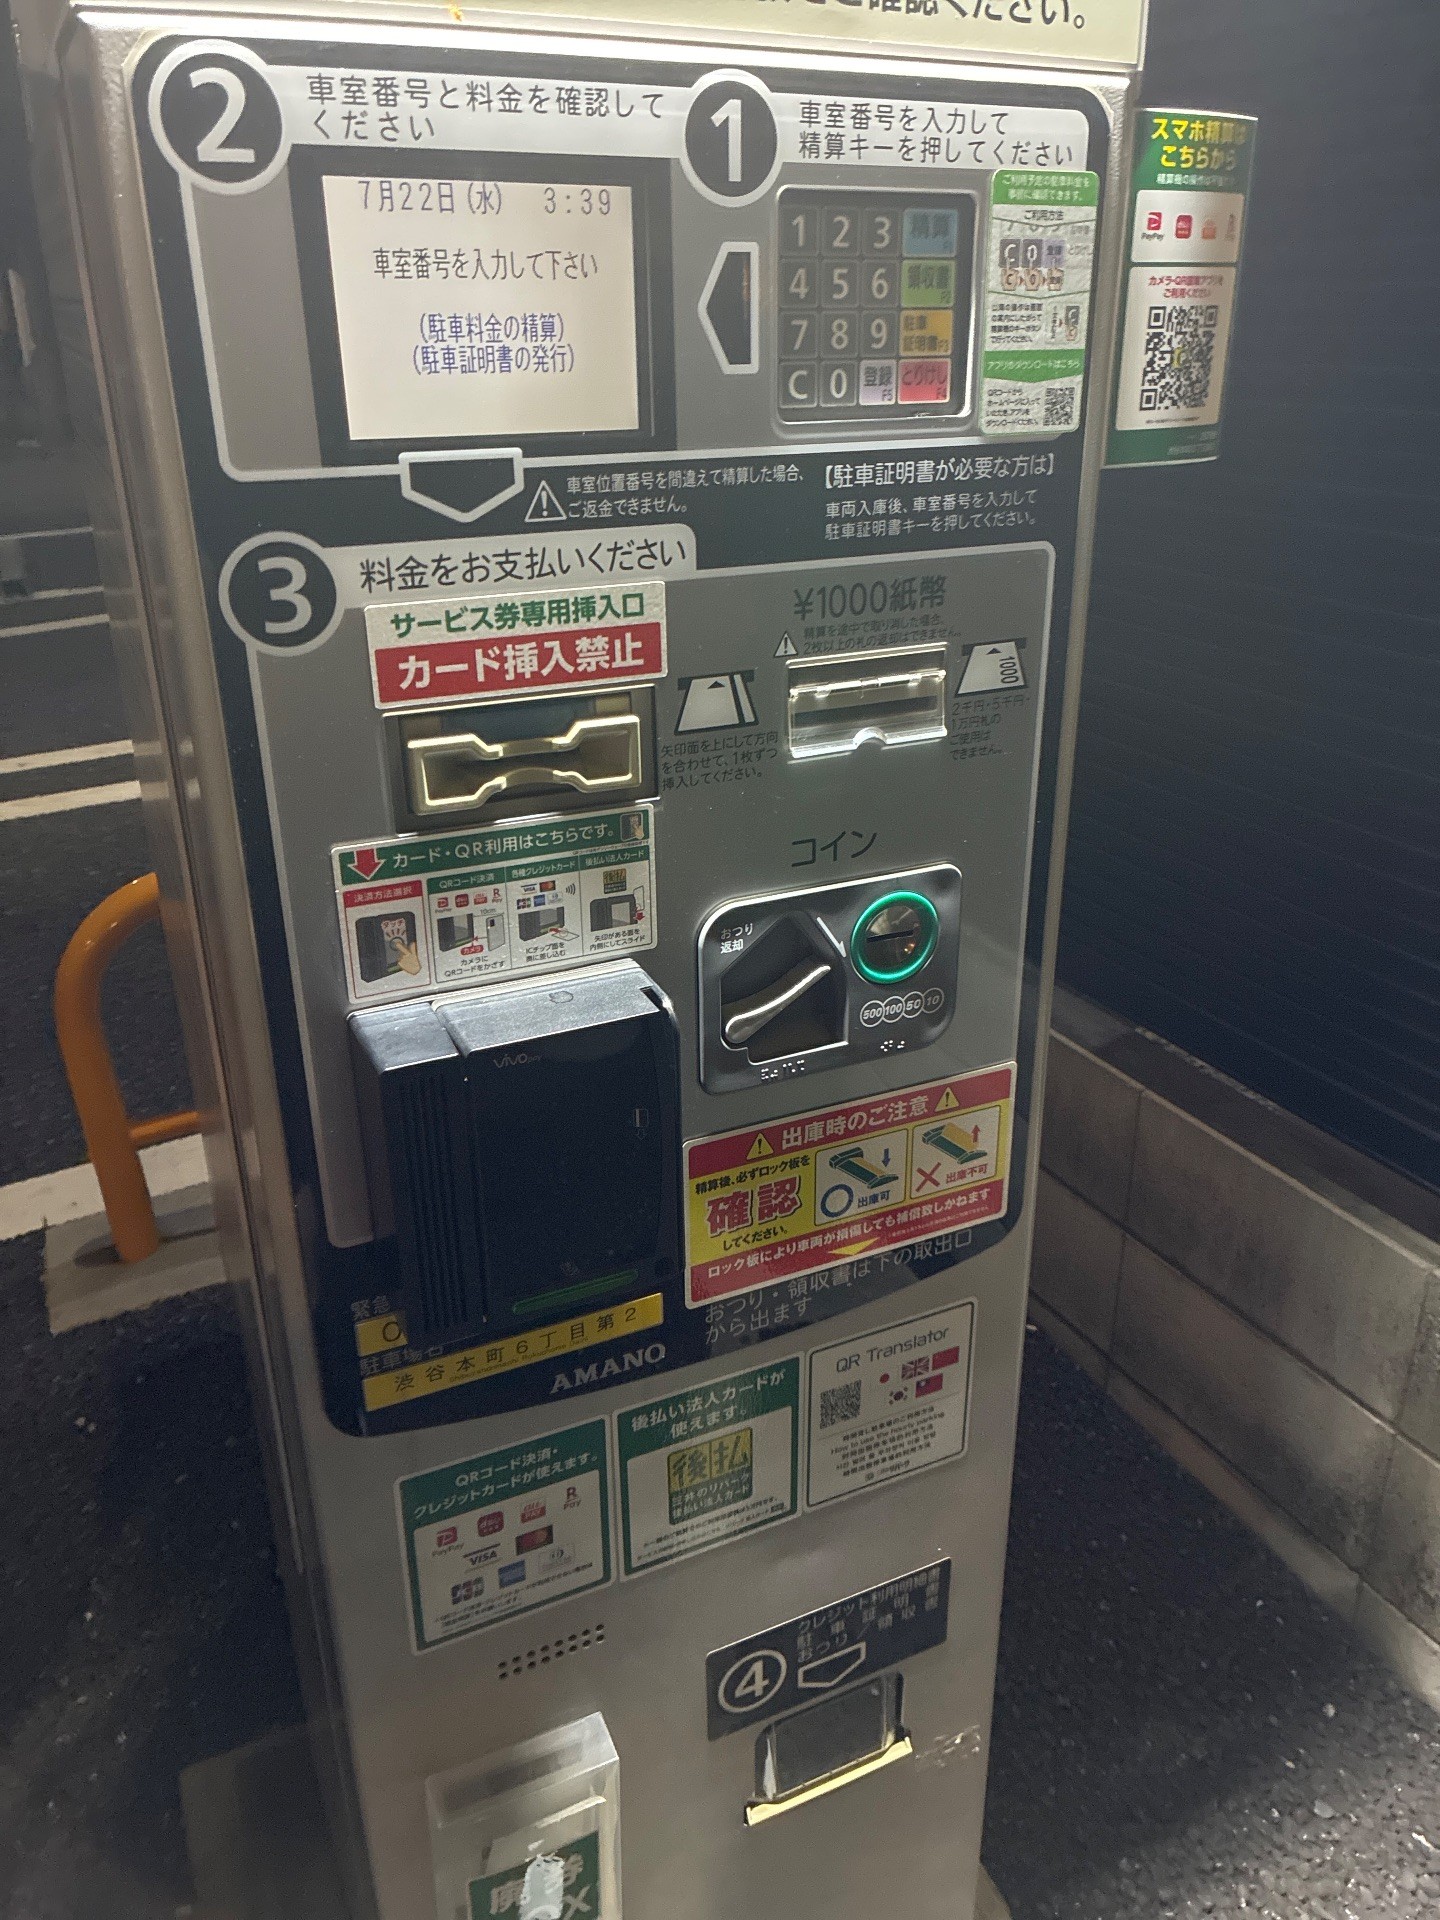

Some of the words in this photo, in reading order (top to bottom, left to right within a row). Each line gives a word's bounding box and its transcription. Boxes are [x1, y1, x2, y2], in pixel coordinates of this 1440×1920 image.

[306, 73, 664, 119] 車室番号と料金を確認して
[189, 68, 255, 163] 2
[312, 111, 436, 142] ください
[799, 100, 1008, 136] 車室番号を入力して
[711, 99, 742, 182] 1
[798, 132, 1073, 166] 精算キーを押してください
[358, 180, 455, 214] 7月22日
[544, 187, 612, 216] 3:39
[792, 215, 805, 247] 1
[832, 216, 850, 248] 2
[875, 216, 892, 247] 3
[373, 248, 599, 281] 車室番号を入力して下さい
[789, 268, 808, 299] 4
[832, 269, 849, 299] 5
[872, 268, 889, 299] 6
[791, 320, 808, 351] 7
[830, 319, 849, 351] 8
[871, 318, 888, 349] 9
[788, 370, 808, 400] C
[830, 369, 847, 398] 0
[566, 463, 804, 495] 車室位置番号を間違えて精算した場合、
[825, 453, 1055, 490] 【駐車証明書が必要な方は】
[567, 495, 688, 519] ご返金できません。
[825, 489, 1039, 519] 車両入庫後、車室番号を入力して
[825, 511, 1037, 541] 駐車証明書キーを押してください。
[359, 537, 687, 594] 料金をお支払いください
[258, 556, 312, 635] 3
[390, 593, 645, 638] サービス券専用挿入口
[399, 637, 645, 690] カード挿入禁止
[393, 822, 615, 870] カード・QR利用はこちらです。
[791, 830, 878, 868] コイン
[438, 872, 496, 890] QRコード決済
[720, 922, 754, 940] おつり
[720, 938, 744, 954] 返却
[444, 959, 506, 978] QRコードをかざす
[863, 1006, 883, 1021] 500
[884, 1003, 903, 1017] 100
[905, 998, 922, 1012] 50
[781, 1095, 929, 1150] 出庫時のご注意
[945, 1163, 988, 1184] 出庫不可
[706, 1175, 802, 1239] 確認
[857, 1190, 891, 1209] 出庫可
[722, 1225, 789, 1251] してください。
[706, 1297, 813, 1344] から出ます
[836, 1353, 861, 1374] QR
[868, 1327, 949, 1363] Translator
[550, 1343, 667, 1395] AMANO
[631, 1368, 786, 1433] 後払い法人カードが
[669, 1405, 747, 1439] 使えます。
[413, 1452, 598, 1520] クレジットカードが使えます。
[470, 1550, 497, 1566] VISA
[735, 1660, 769, 1698] 4
